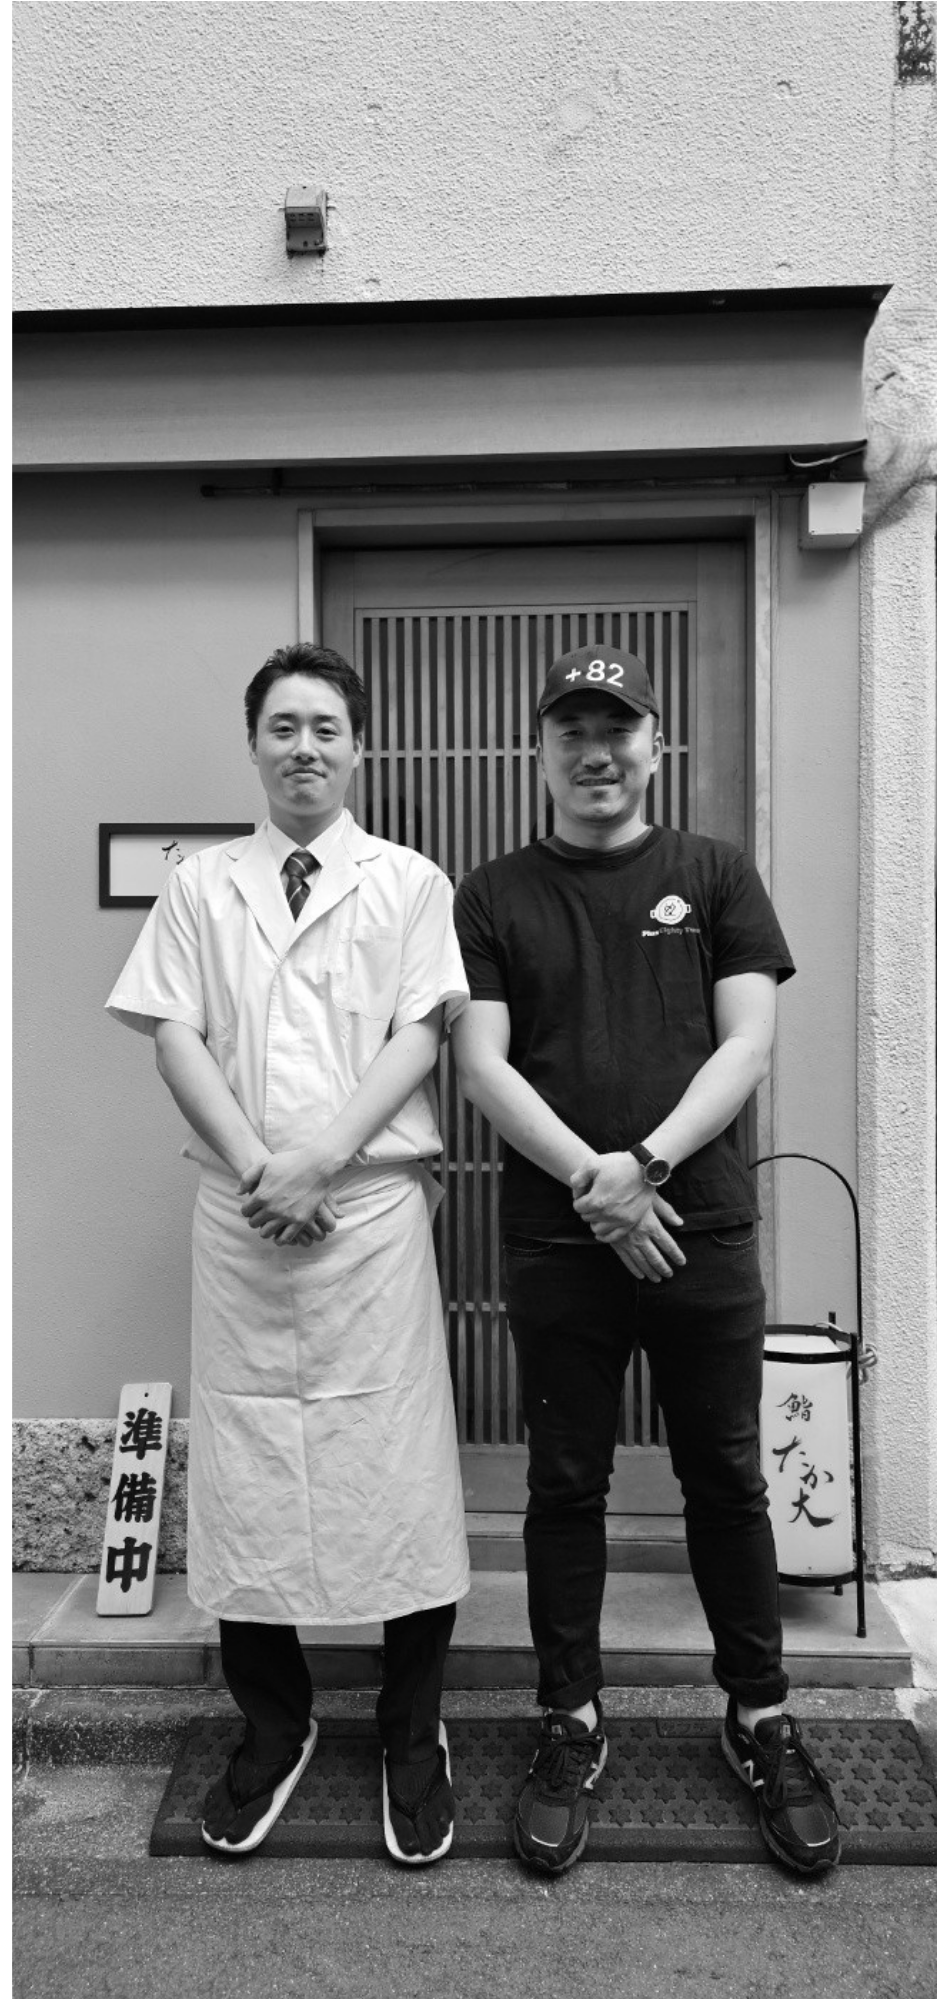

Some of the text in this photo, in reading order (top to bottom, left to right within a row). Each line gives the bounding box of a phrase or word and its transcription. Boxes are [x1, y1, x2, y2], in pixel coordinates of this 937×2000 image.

[565, 659, 624, 688] +82
[106, 1407, 163, 1593] 準備中
